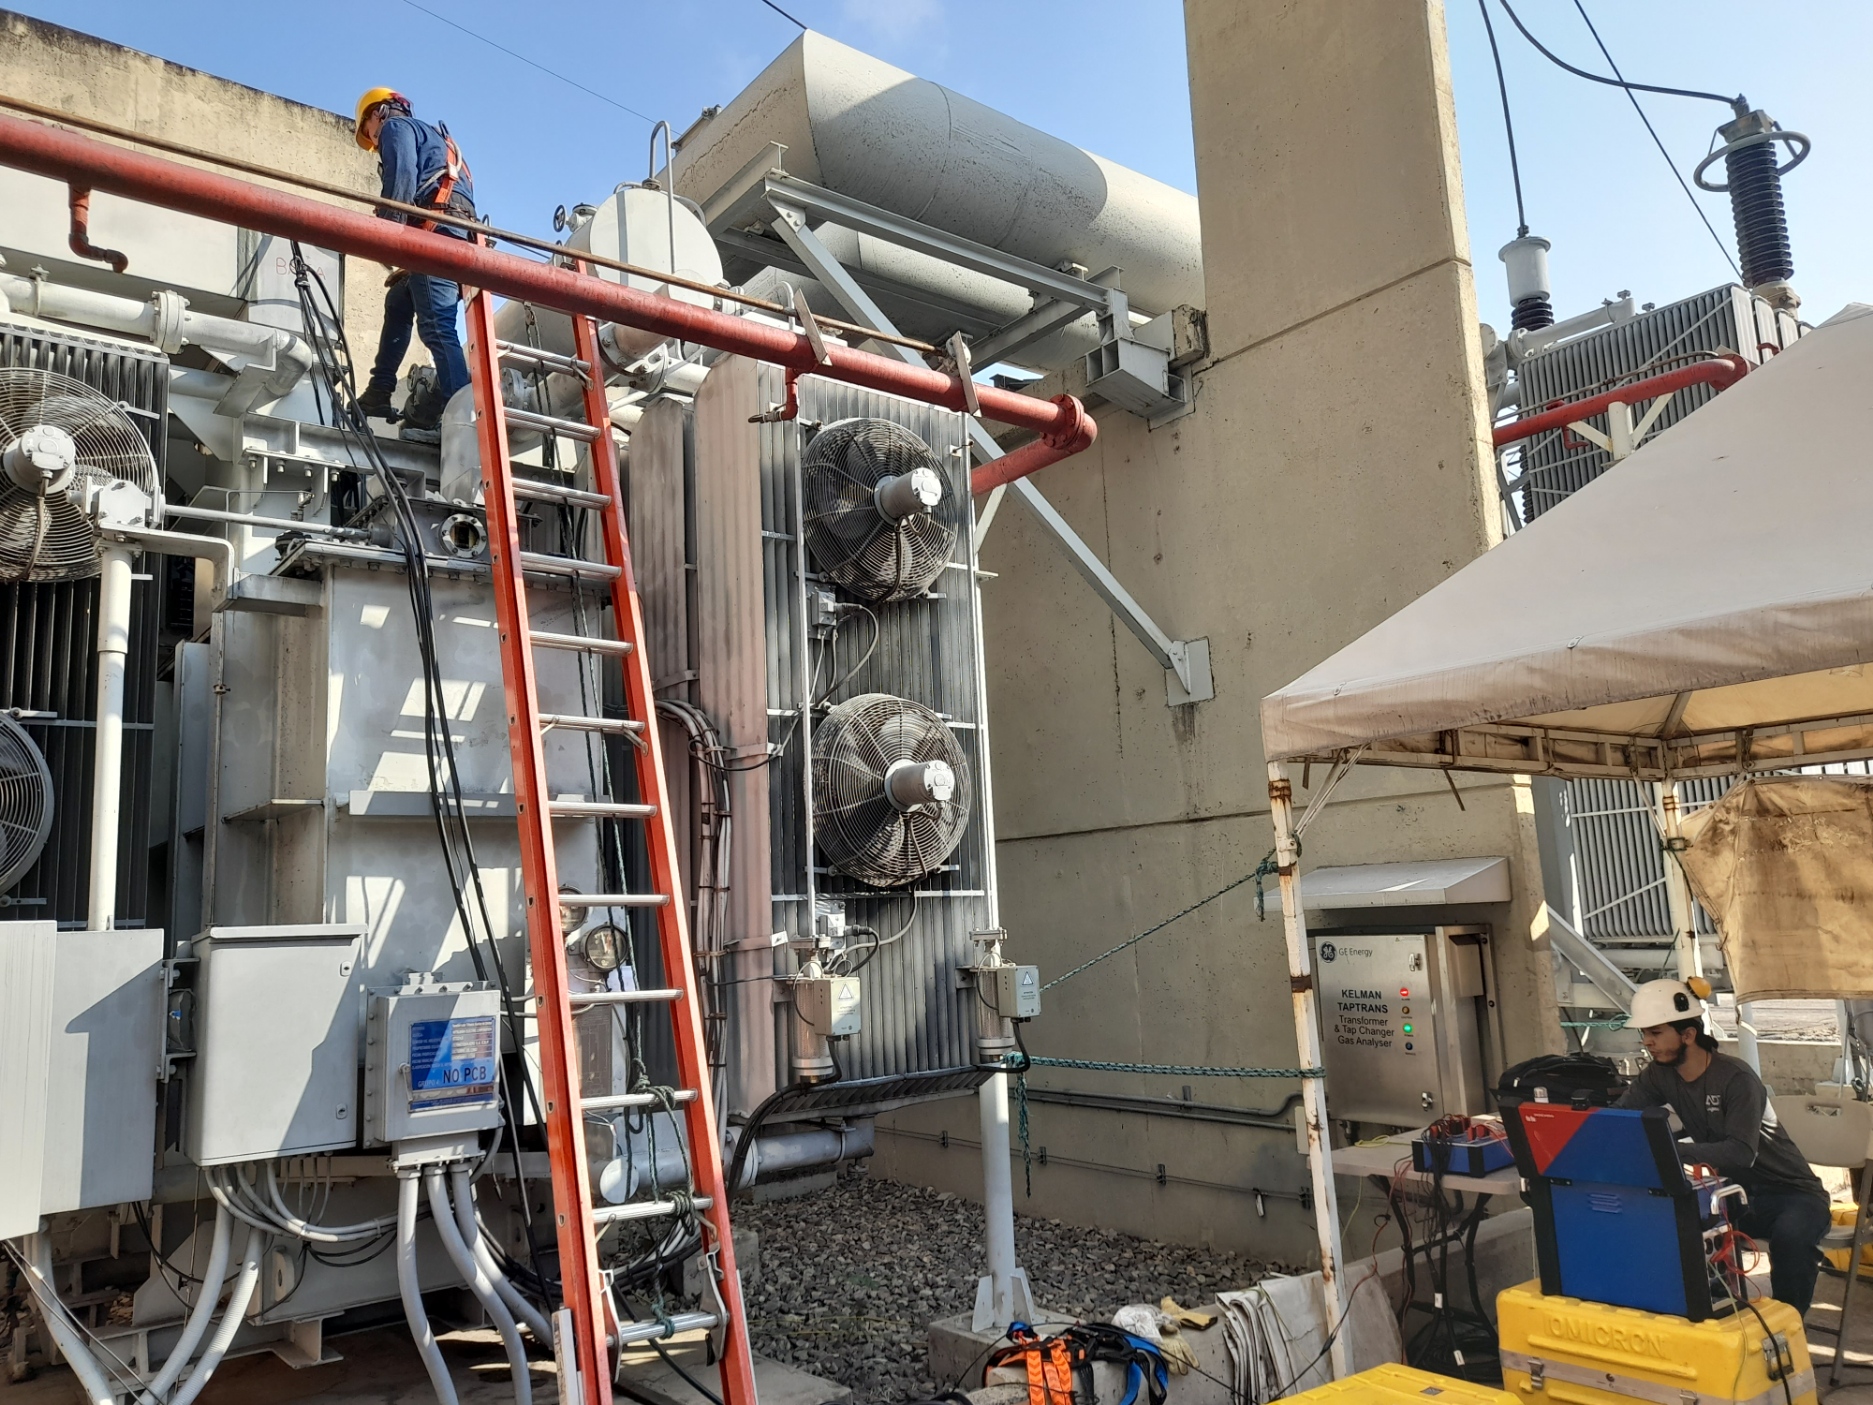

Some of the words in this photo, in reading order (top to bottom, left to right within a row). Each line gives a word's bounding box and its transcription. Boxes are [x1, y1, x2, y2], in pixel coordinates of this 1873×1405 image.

[1338, 948, 1348, 956] GE
[1349, 948, 1373, 957] Energy
[1341, 989, 1382, 1000] KELMAN
[1337, 1002, 1389, 1014] TAPTRANS
[1339, 1014, 1389, 1027] Transformer
[1334, 1024, 1341, 1034] &
[1342, 1025, 1357, 1036] Tap
[1358, 1027, 1395, 1038] Changer
[1337, 1035, 1355, 1046] Gas
[1356, 1036, 1392, 1049] Analyser
[443, 1068, 460, 1084] NO
[464, 1066, 487, 1082] PCB
[1549, 1317, 1667, 1360] OMICRON
